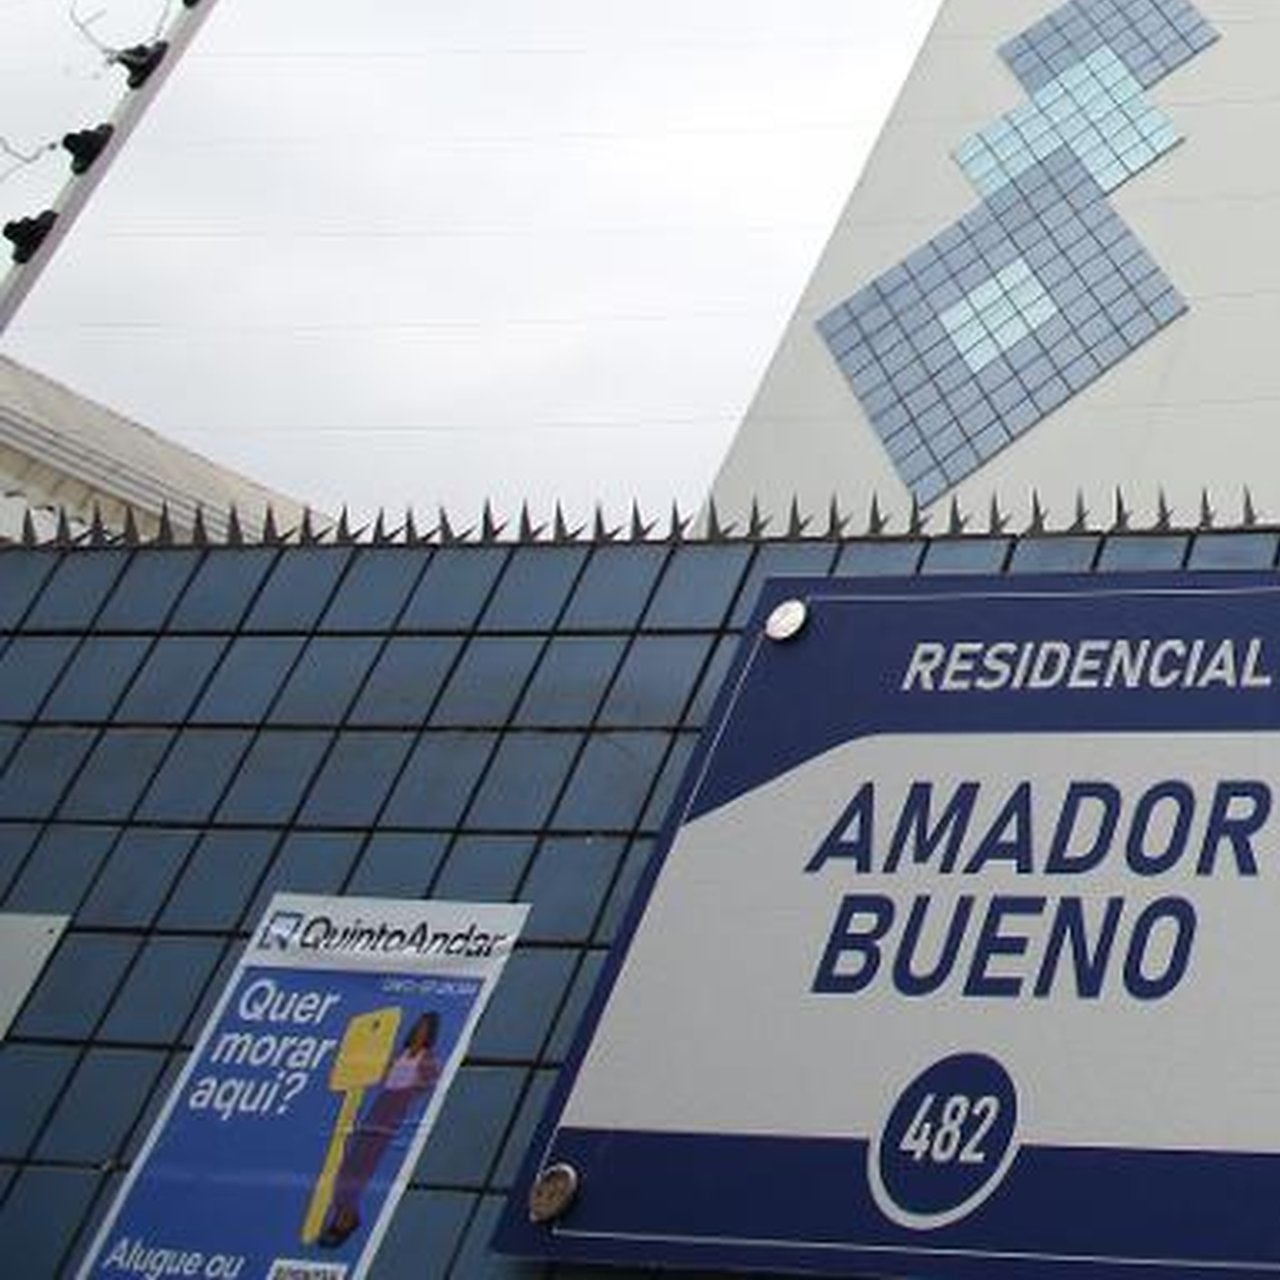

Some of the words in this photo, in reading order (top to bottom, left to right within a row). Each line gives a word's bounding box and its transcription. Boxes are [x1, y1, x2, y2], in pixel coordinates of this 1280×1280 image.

[901, 638, 1273, 692] RESIDENCIAL
[804, 780, 1274, 876] AMADOR
[301, 916, 506, 958] QuintoAndar
[810, 894, 1197, 999] BUENO
[238, 978, 339, 1024] Quer
[210, 1027, 338, 1070] morar
[188, 1072, 308, 1120] aqui?
[899, 1094, 1000, 1165] 482
[102, 1238, 201, 1279] Alugue
[205, 1253, 246, 1278] ou
